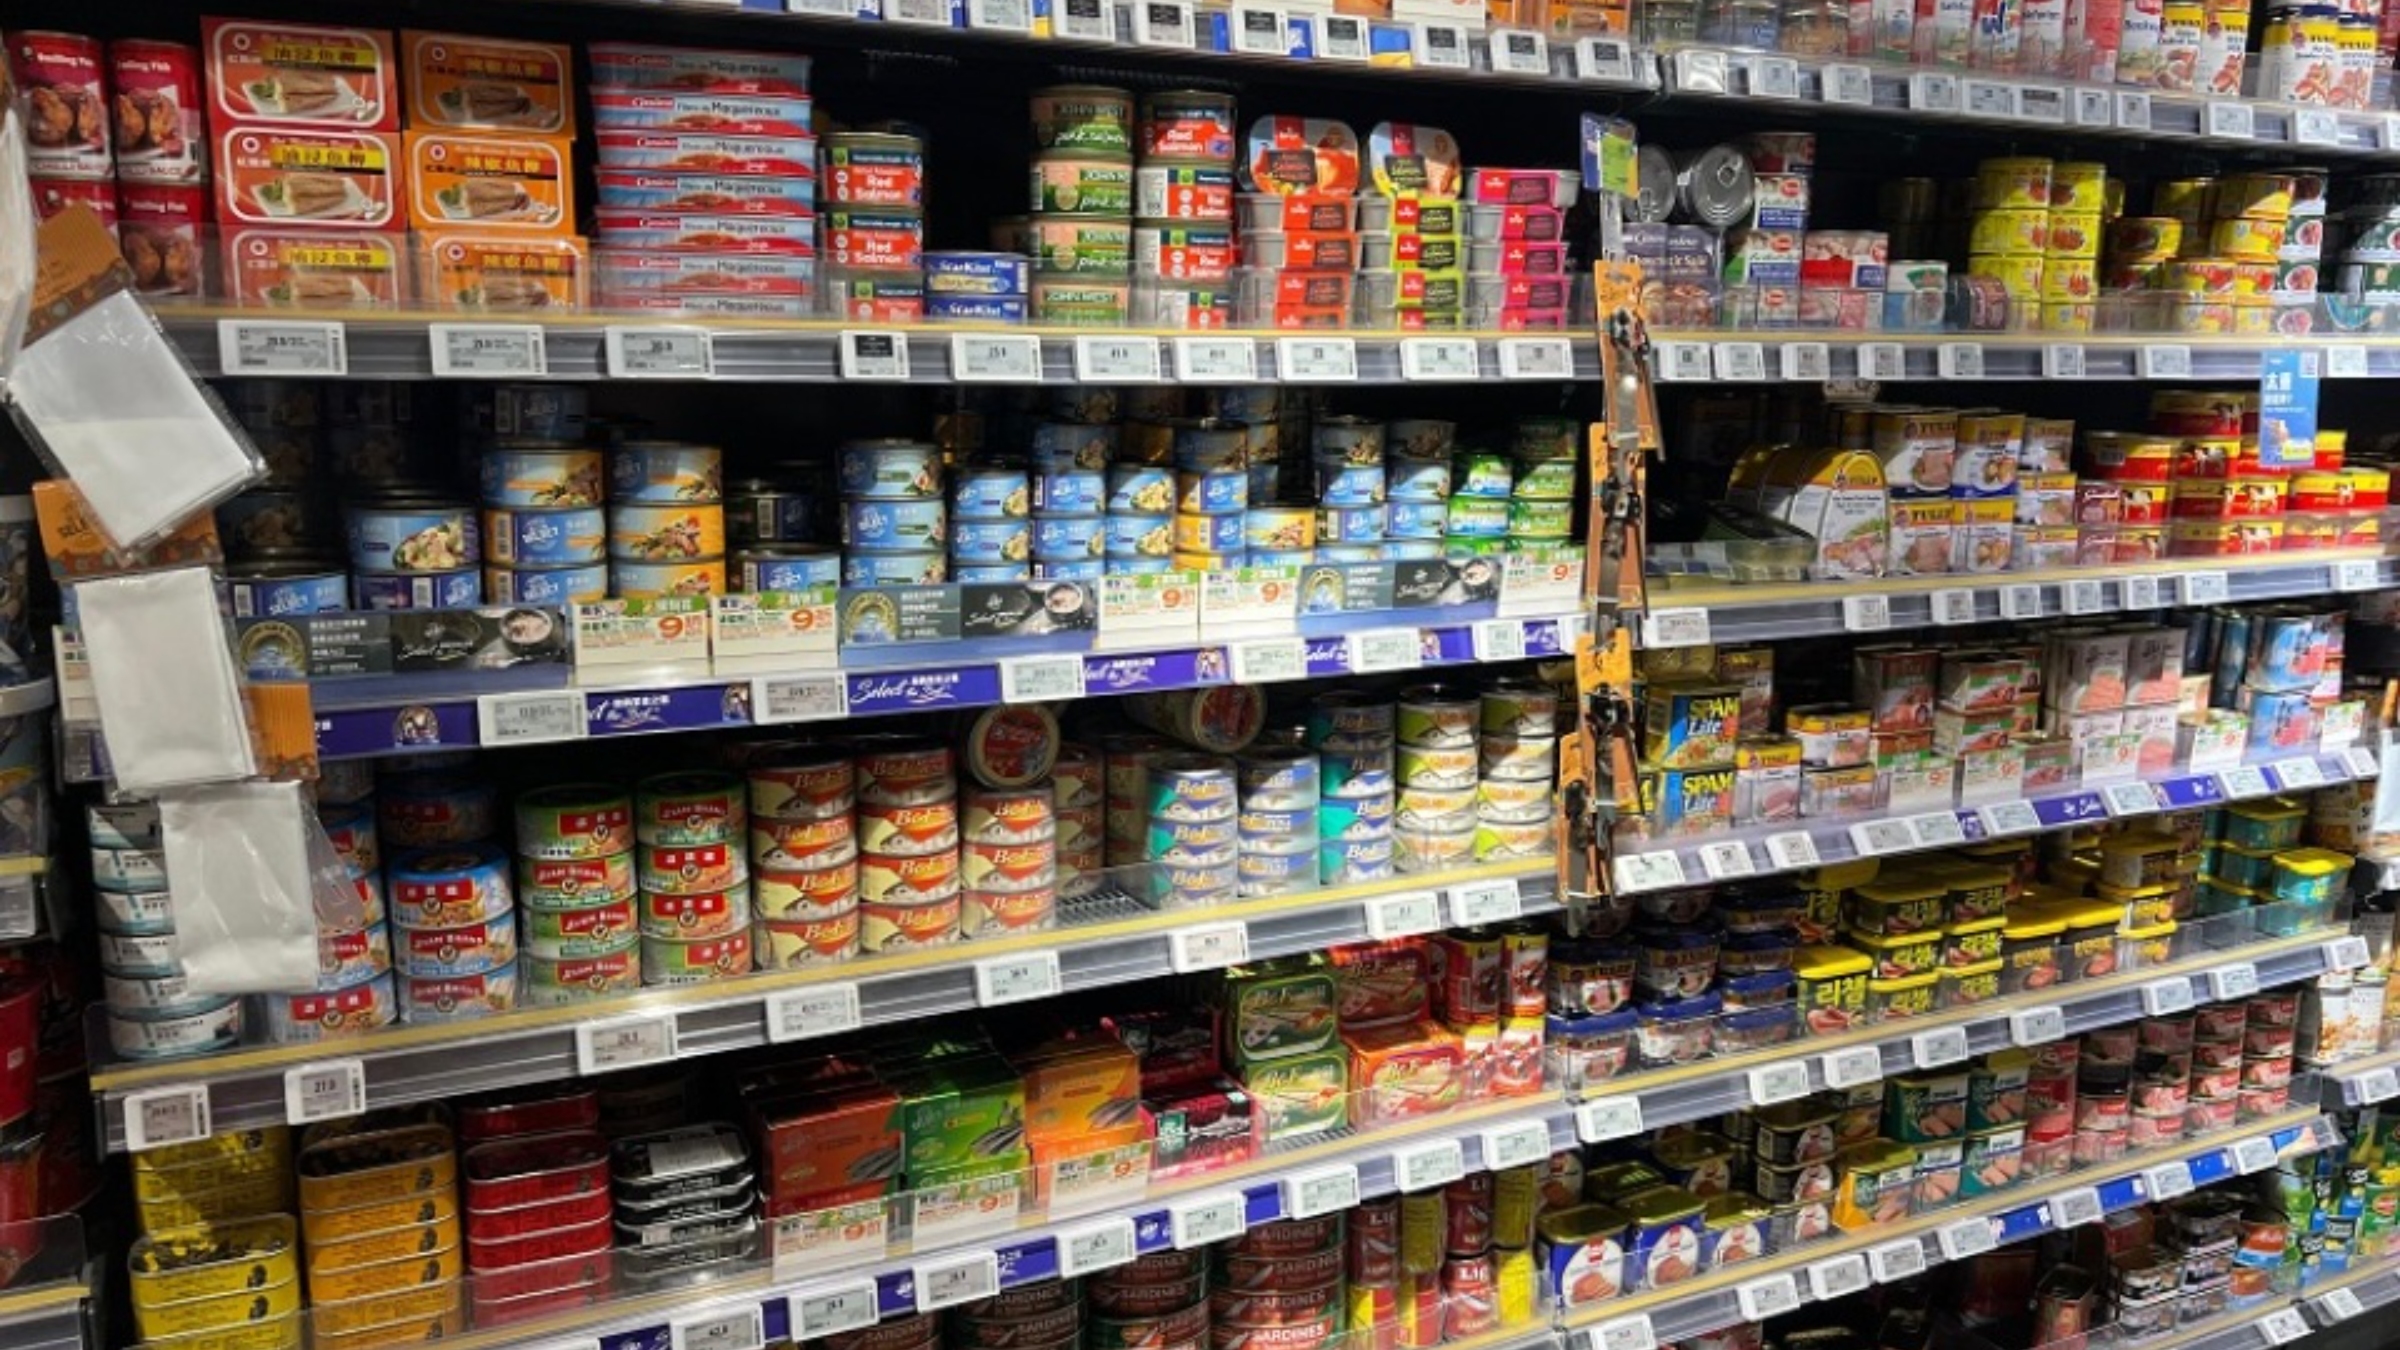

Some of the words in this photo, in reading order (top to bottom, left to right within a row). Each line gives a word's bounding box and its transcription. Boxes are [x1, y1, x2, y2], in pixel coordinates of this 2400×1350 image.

[866, 175, 894, 187] Red
[854, 187, 904, 201] Salmon
[866, 239, 892, 252] Red
[853, 252, 904, 265] Salmon
[658, 616, 683, 639] 9
[791, 608, 815, 631] 9
[1688, 697, 1739, 718] SPAM
[1688, 717, 1722, 736] Lite
[1683, 771, 1734, 794] SPAM
[1252, 1322, 1325, 1341] SARDINES
